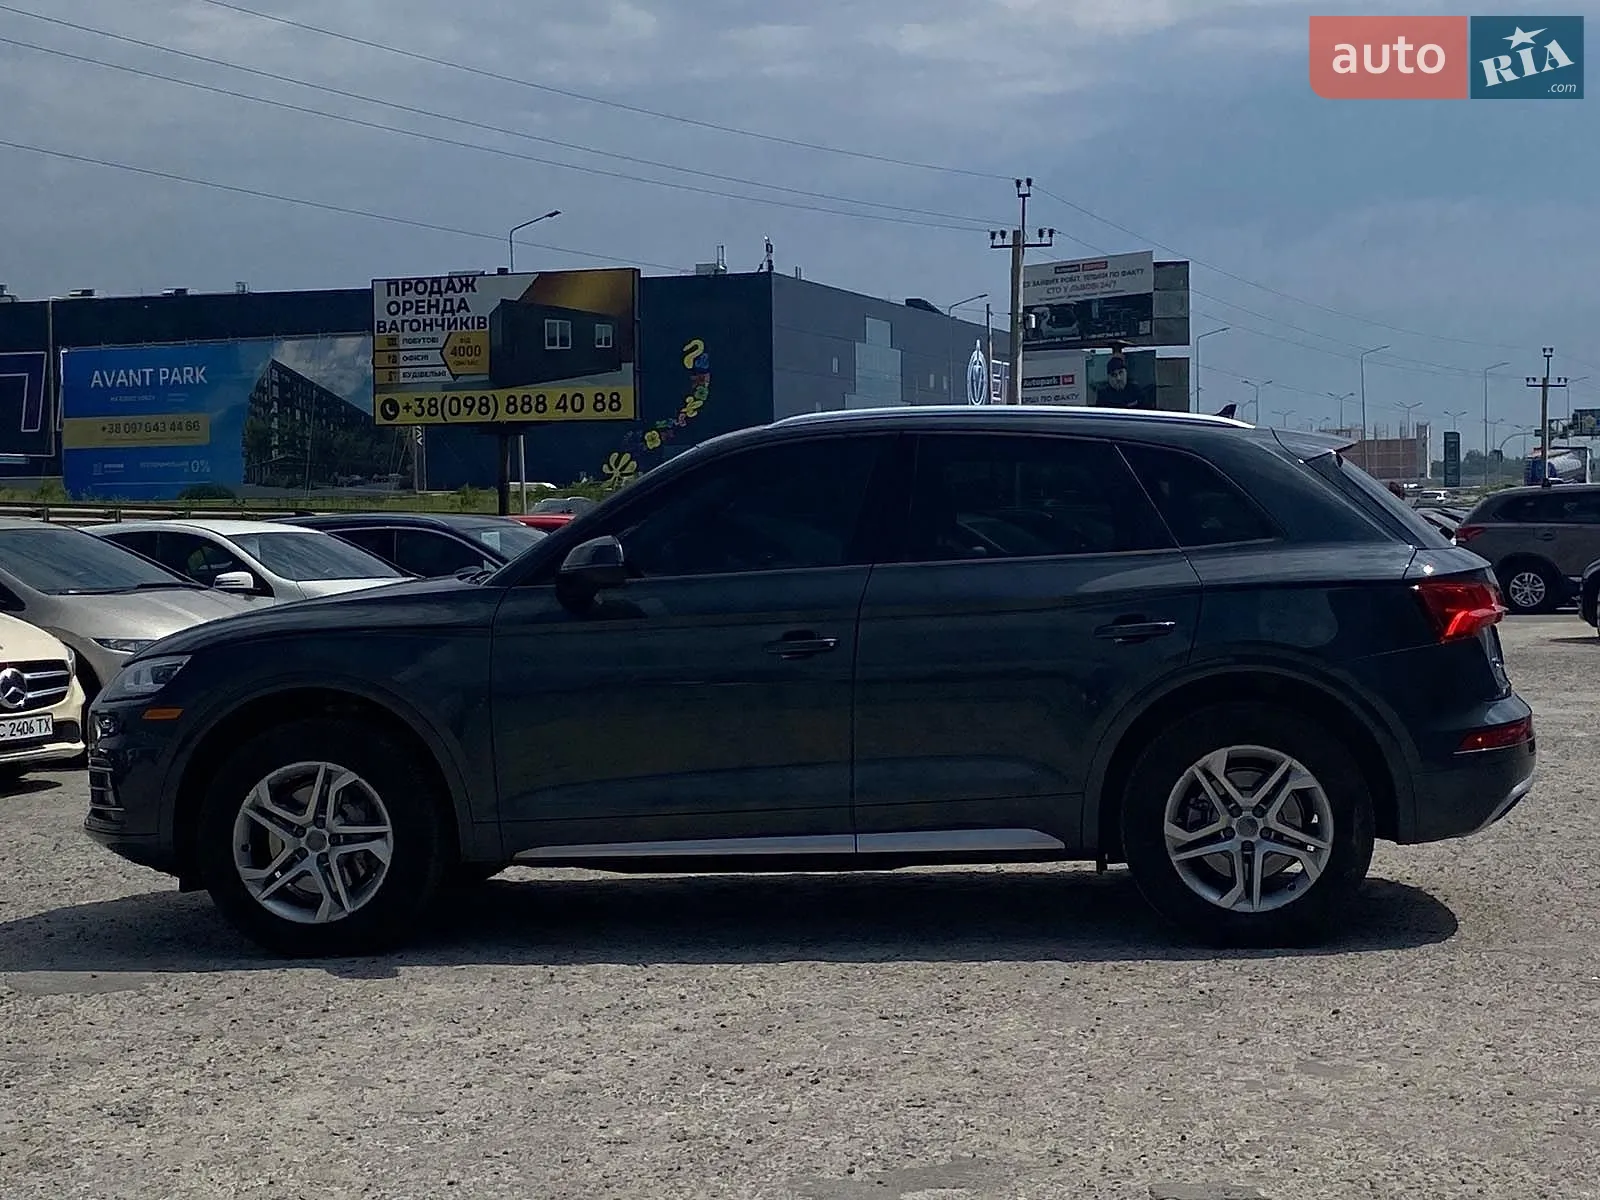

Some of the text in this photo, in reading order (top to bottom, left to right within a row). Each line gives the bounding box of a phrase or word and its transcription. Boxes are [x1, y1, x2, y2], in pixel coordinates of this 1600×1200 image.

[386, 277, 477, 297] ПРОДАЖ
[386, 298, 471, 317] ОРЕНДА
[376, 316, 488, 334] ВАГОНЧИКІВ
[450, 345, 482, 357] 4000
[90, 365, 208, 389] AVANT PARK
[402, 391, 622, 422] +38(098) 888 40 88
[9, 720, 35, 736] 2406
[36, 718, 51, 733] TX
